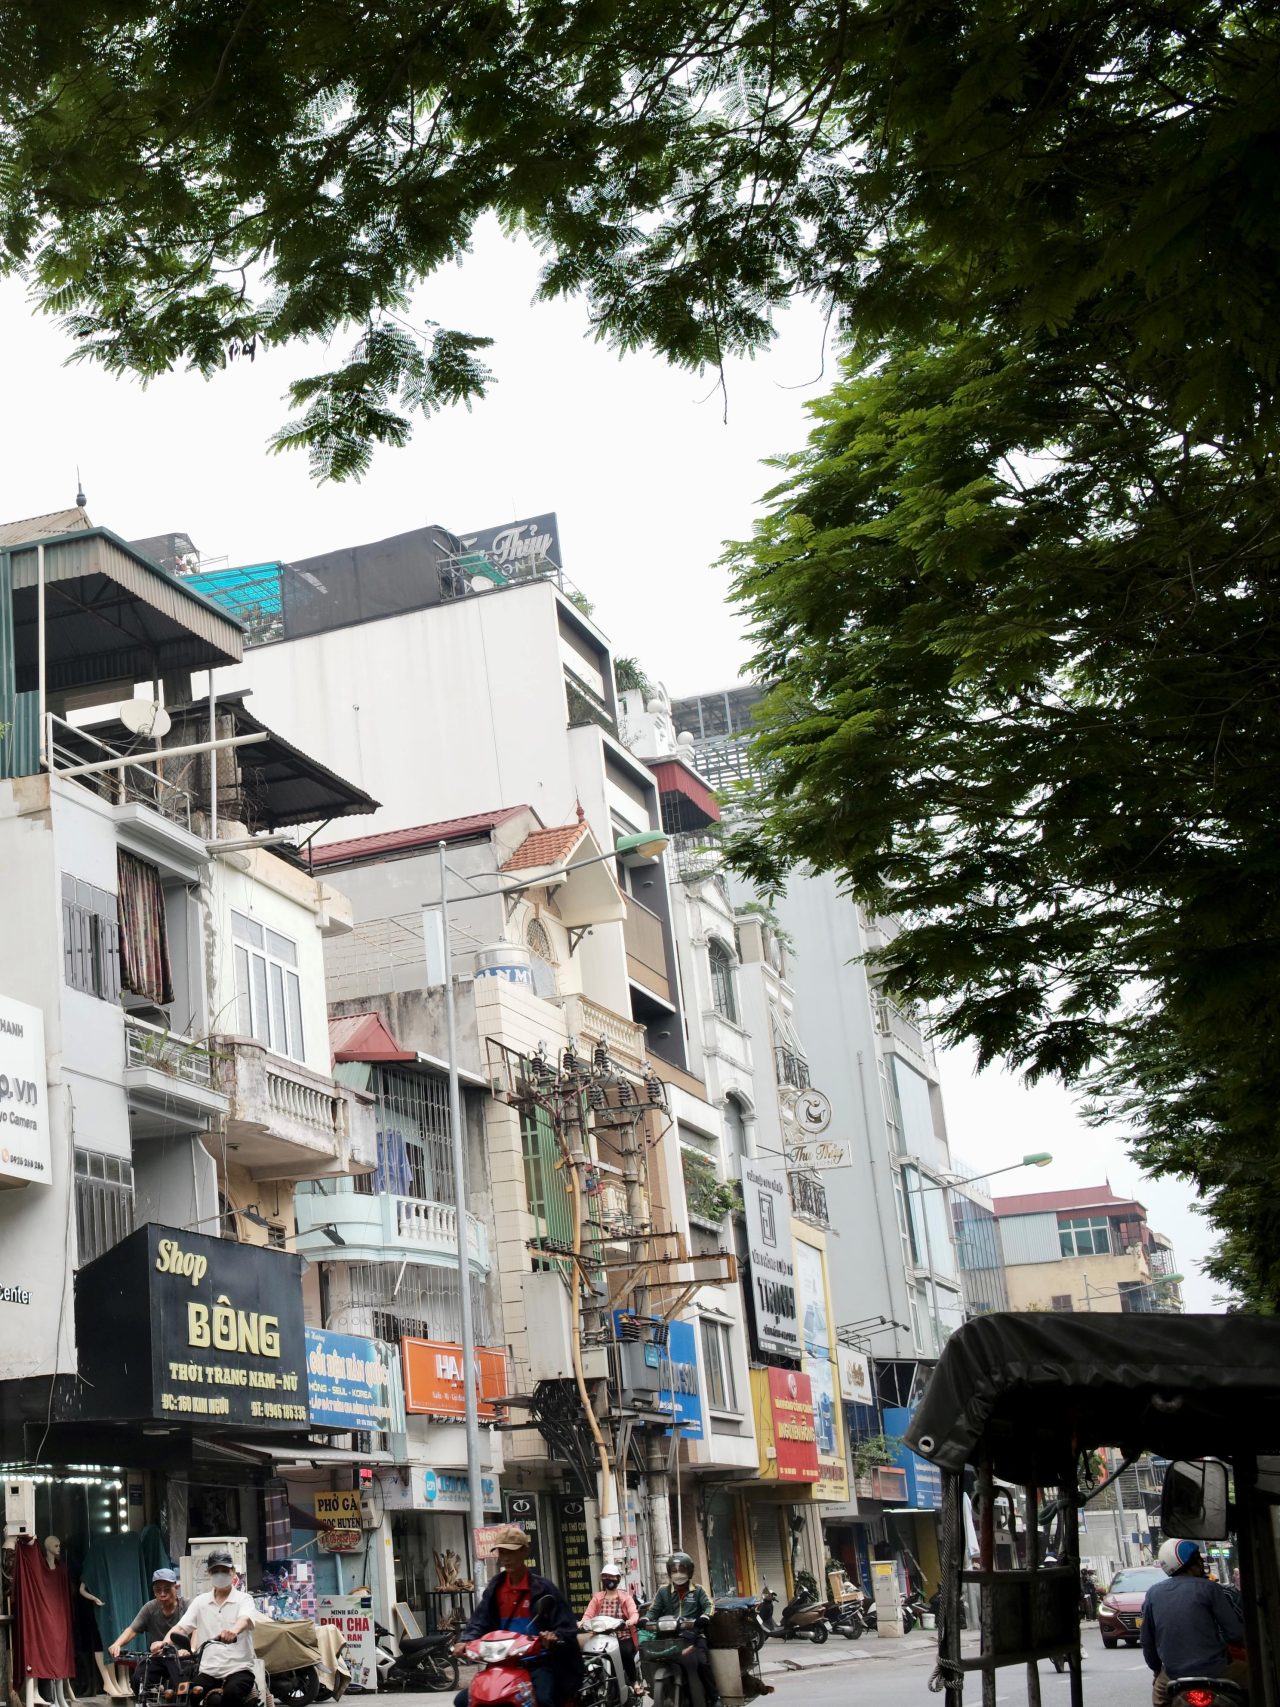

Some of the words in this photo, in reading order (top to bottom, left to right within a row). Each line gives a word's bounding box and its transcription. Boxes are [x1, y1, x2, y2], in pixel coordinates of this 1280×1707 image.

[10, 1110, 37, 1130] Camera
[156, 1239, 207, 1286] Shop
[187, 1295, 280, 1358] BÔNG
[169, 1361, 203, 1382] THỜI
[206, 1367, 247, 1385] TRANG
[249, 1372, 276, 1389] NAM
[283, 1372, 298, 1392] NỮ
[192, 1397, 208, 1413] KIM
[318, 1493, 339, 1511] PHỞ
[342, 1494, 358, 1510] GÀ
